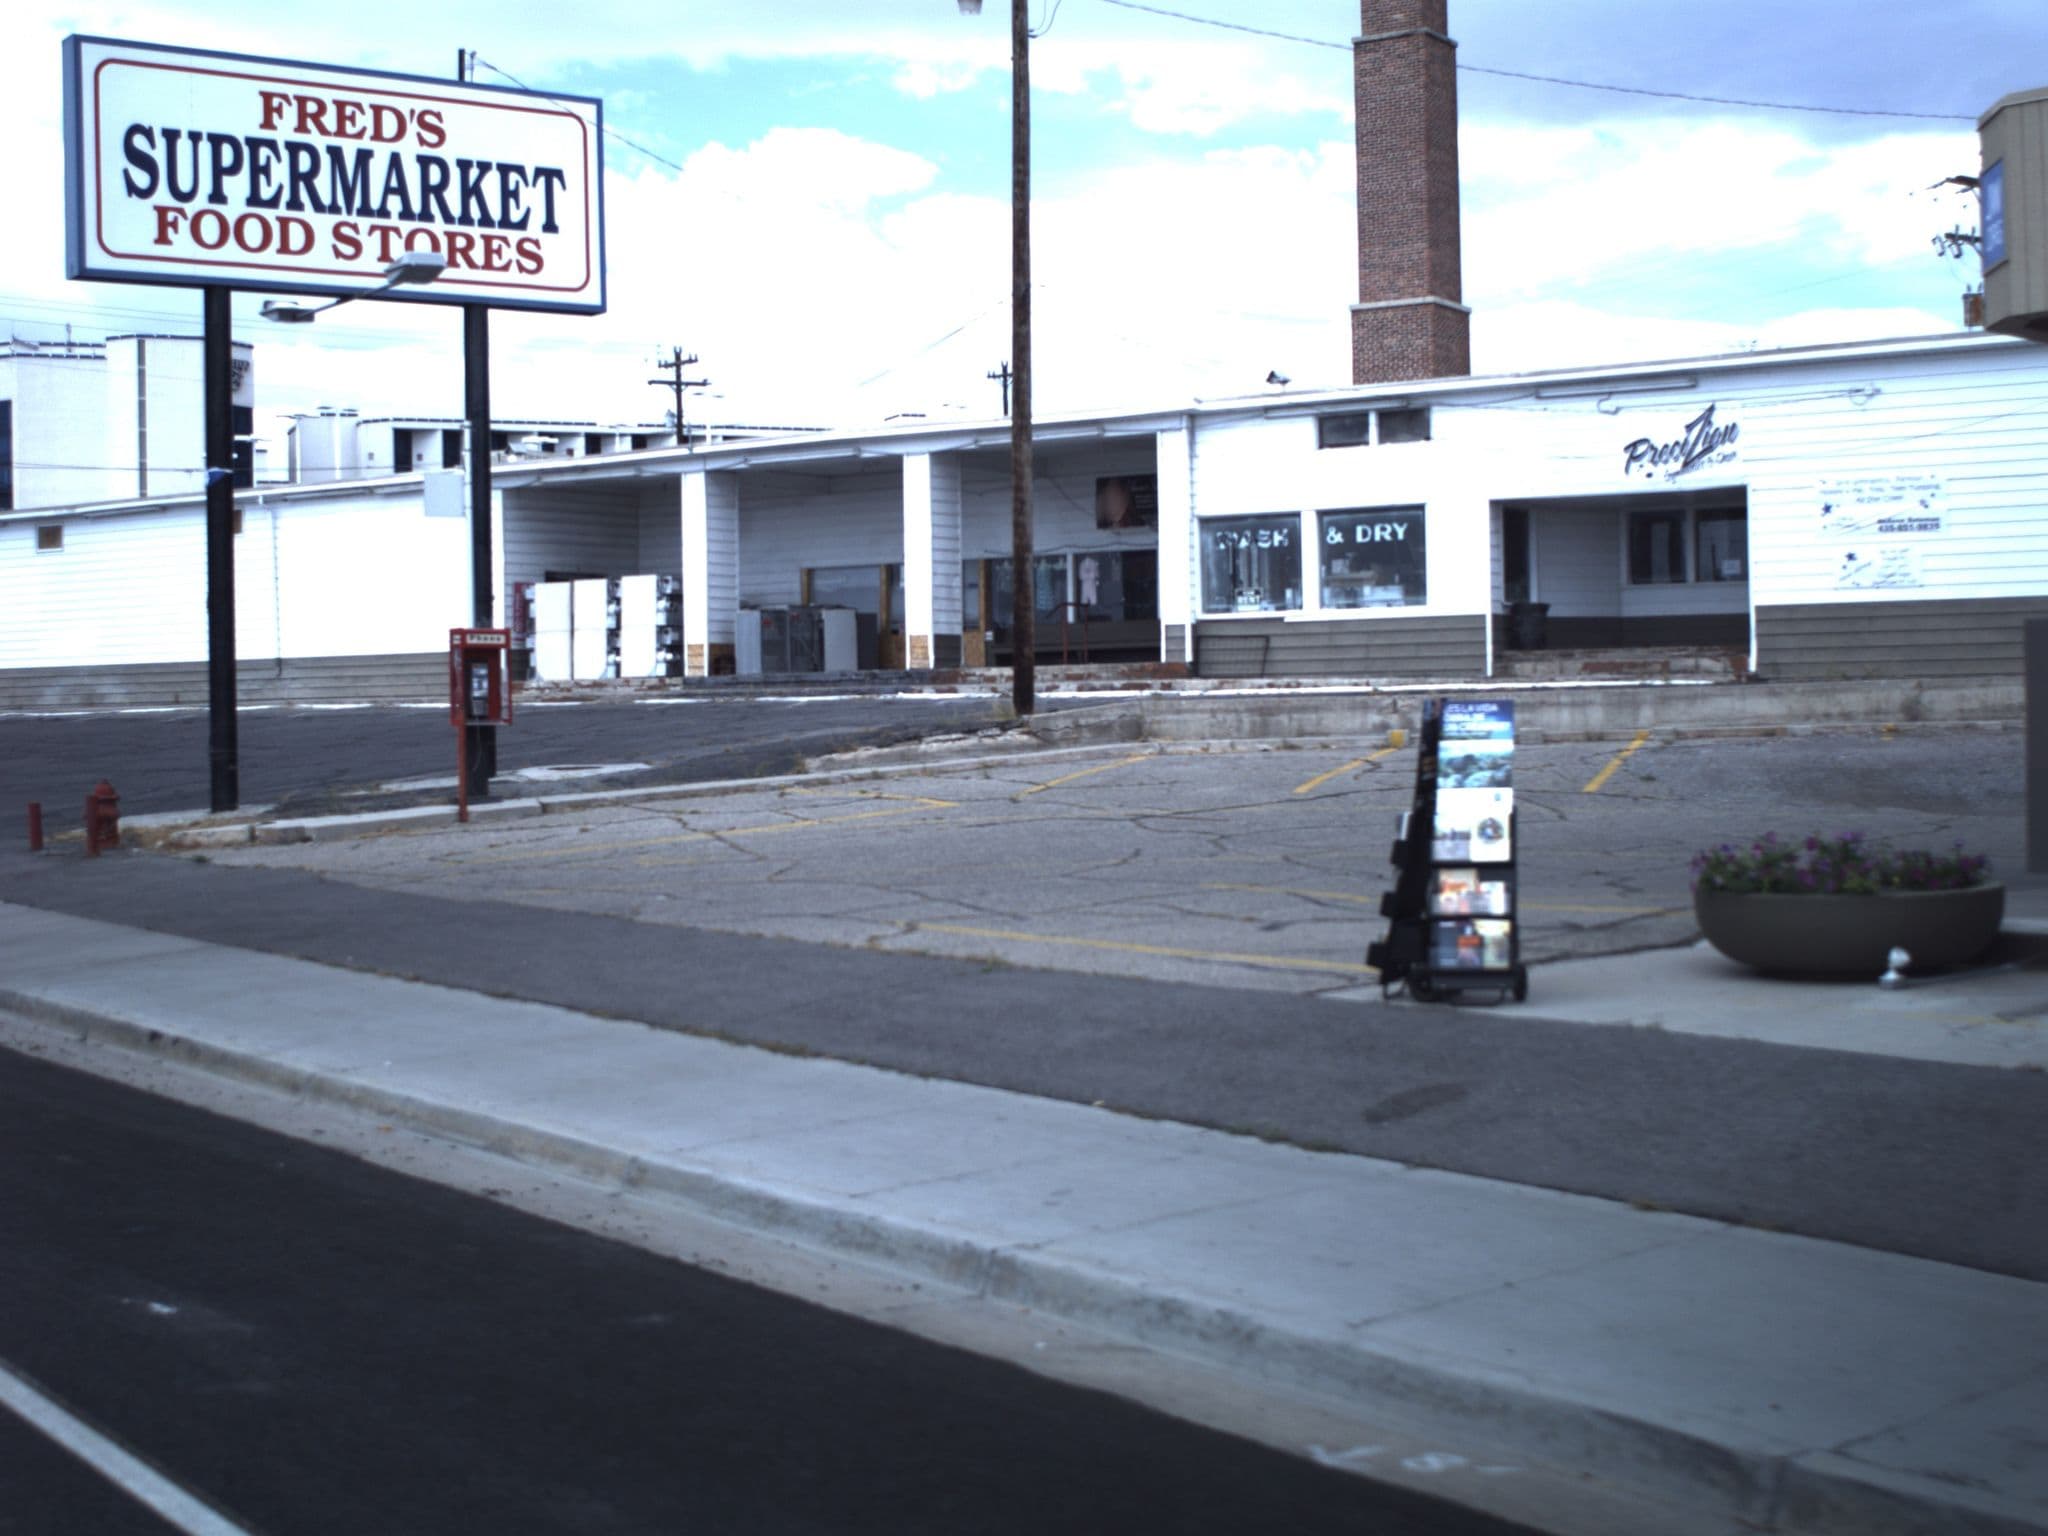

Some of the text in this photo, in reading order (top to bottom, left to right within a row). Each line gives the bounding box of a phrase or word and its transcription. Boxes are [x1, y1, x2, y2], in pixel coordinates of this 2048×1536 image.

[258, 90, 447, 149] FRED'S
[122, 122, 567, 235] SUPERMARKET
[153, 204, 545, 276] FOOD STORES
[1326, 526, 1344, 544] &
[1355, 521, 1408, 543] DRY
